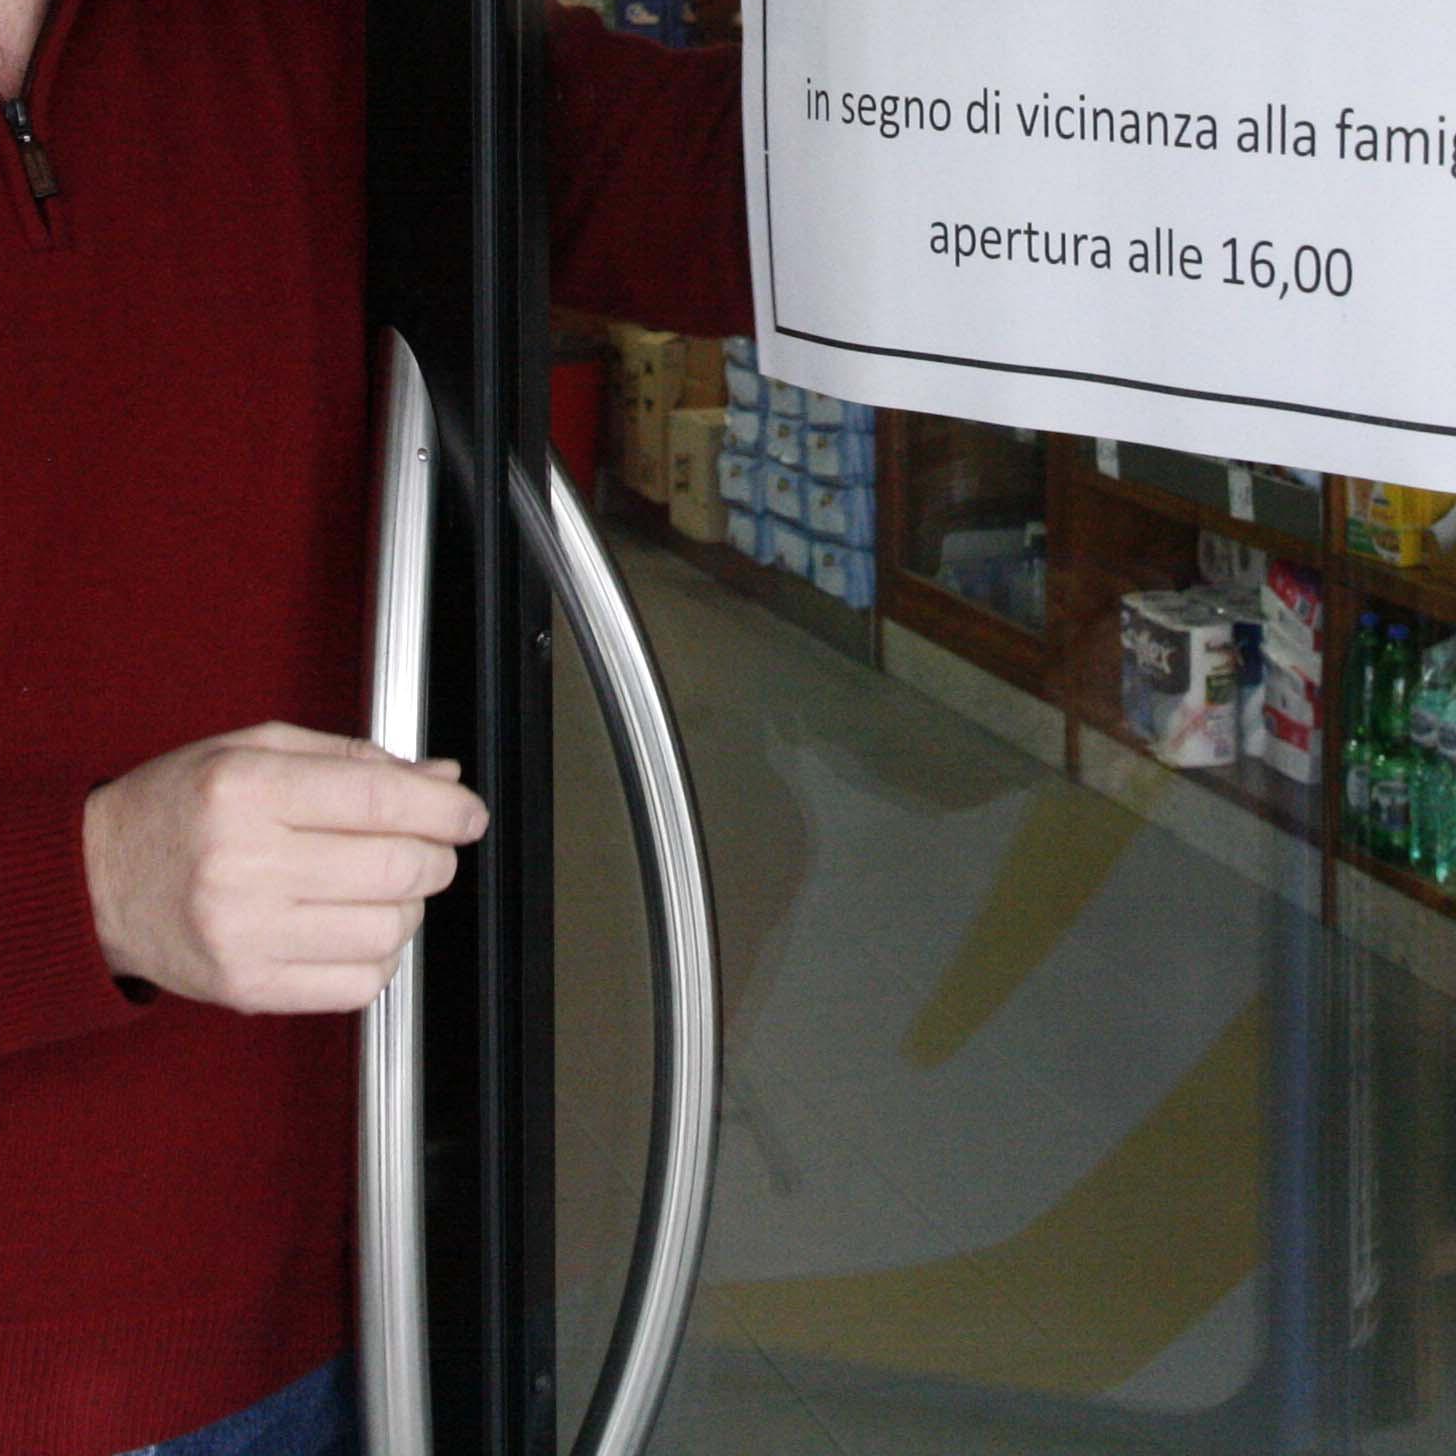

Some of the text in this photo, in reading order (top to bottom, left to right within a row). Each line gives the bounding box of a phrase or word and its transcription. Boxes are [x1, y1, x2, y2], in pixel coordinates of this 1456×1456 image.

[806, 77, 830, 122] in
[841, 92, 951, 140] segno
[966, 87, 1000, 136] di
[1016, 92, 1217, 150] vicinanza
[1237, 103, 1316, 157] alla
[930, 221, 1353, 300] apertura alle 16,00
